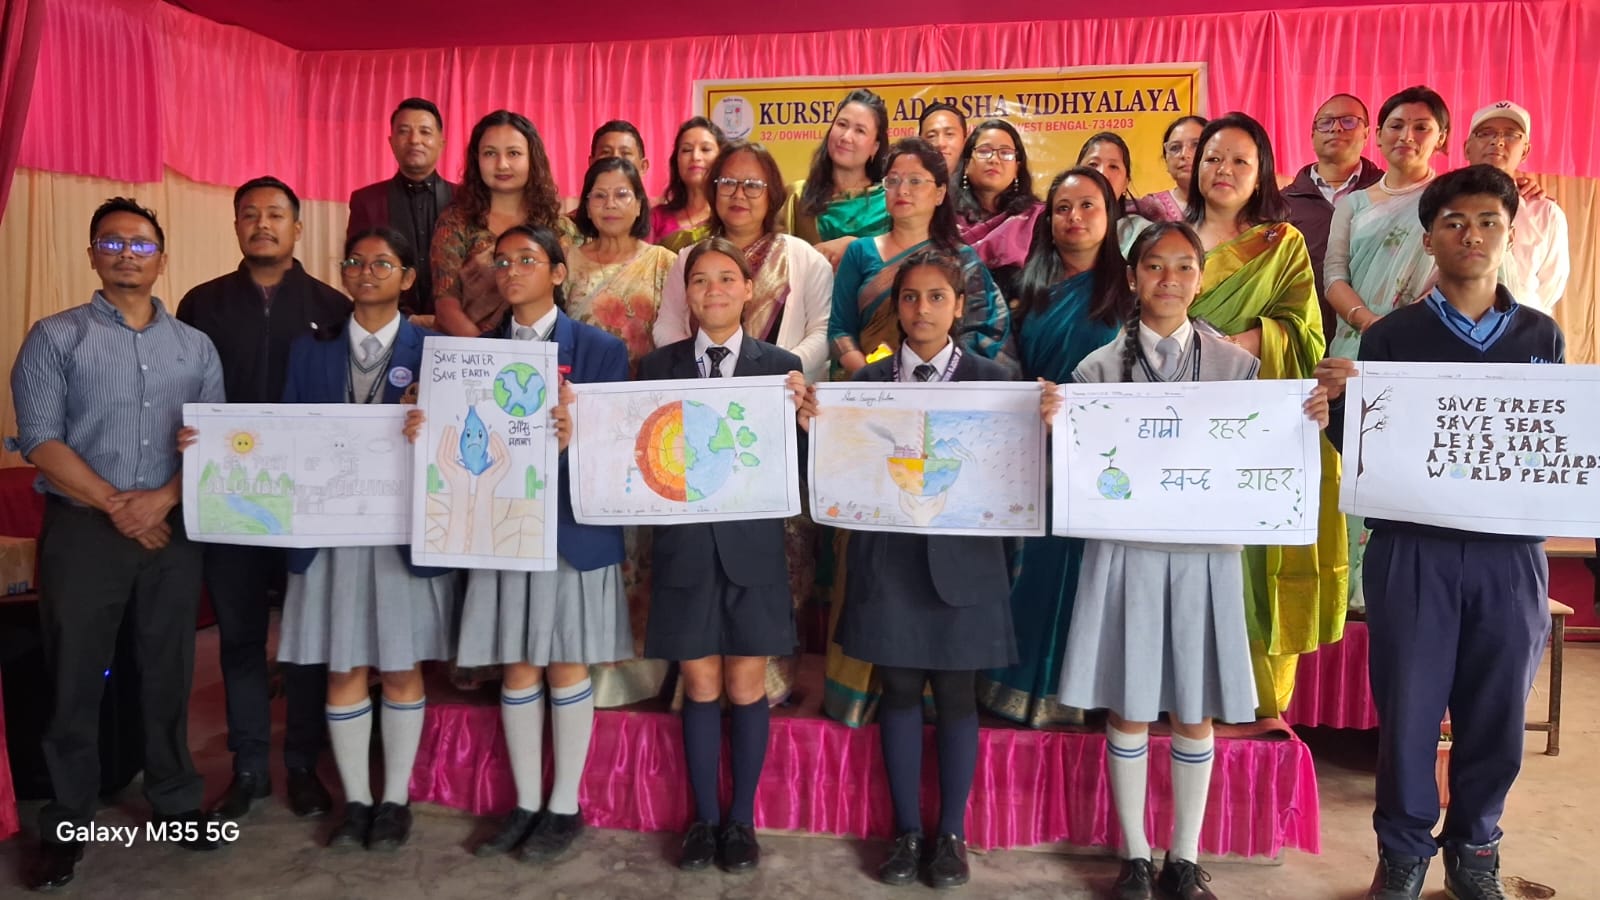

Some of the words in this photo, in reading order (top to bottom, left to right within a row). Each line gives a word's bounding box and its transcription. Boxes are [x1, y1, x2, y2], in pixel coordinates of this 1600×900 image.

[1016, 88, 1181, 116] VIDHYALAYA
[1045, 118, 1134, 132] BENGAL-734203
[434, 351, 457, 364] SAVE
[461, 354, 495, 366] WATER
[432, 367, 457, 383] SAVE
[461, 368, 490, 378] EARTH
[1438, 397, 1487, 412] SAVE
[1494, 397, 1566, 414] TREES
[1436, 415, 1493, 431] SAVE
[1505, 417, 1556, 433] SEAS
[1426, 451, 1438, 463] A
[1447, 450, 1506, 466] STEP
[1520, 468, 1589, 485] PEACE
